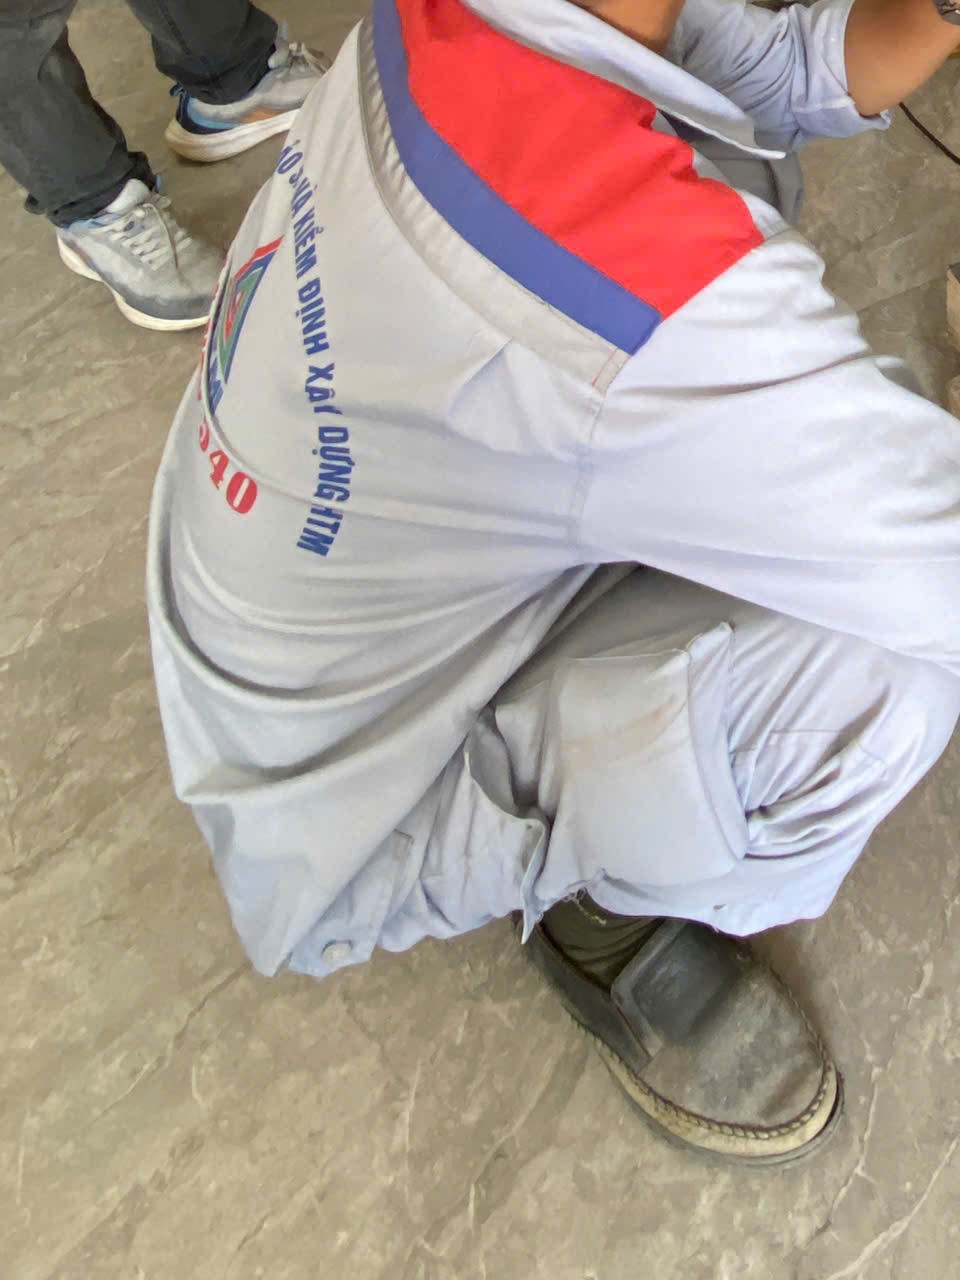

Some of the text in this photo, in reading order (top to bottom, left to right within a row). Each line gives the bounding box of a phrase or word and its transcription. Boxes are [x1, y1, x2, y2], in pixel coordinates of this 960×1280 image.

[293, 206, 325, 280] KIỂM
[296, 277, 330, 355] ĐỊNH
[312, 426, 356, 502] DỰNG
